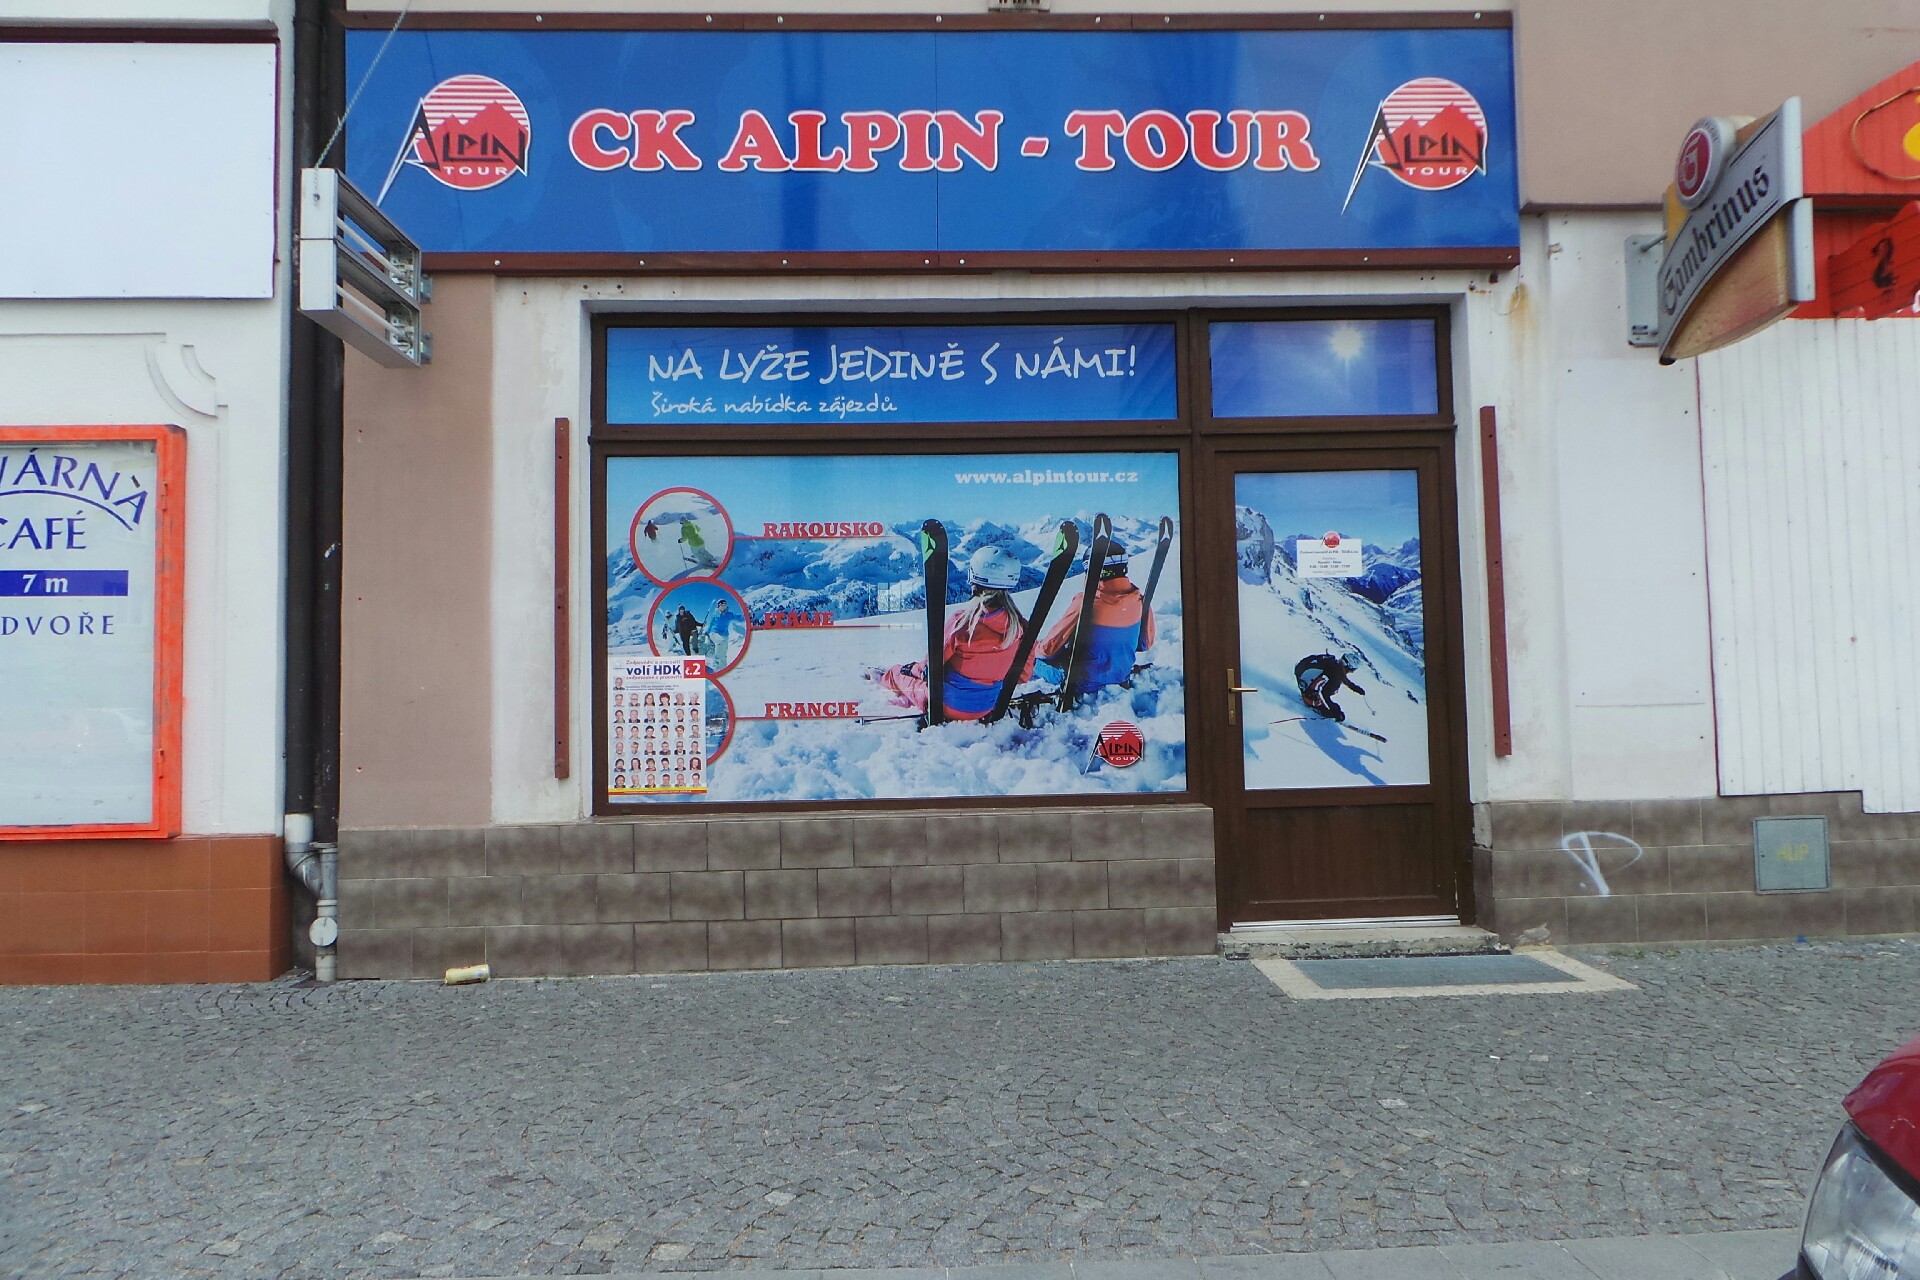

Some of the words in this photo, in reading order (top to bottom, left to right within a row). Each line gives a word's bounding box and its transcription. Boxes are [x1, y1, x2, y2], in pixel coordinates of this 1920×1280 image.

[568, 107, 703, 171] CK
[717, 109, 1004, 172] ALPIN
[1064, 109, 1321, 172] TOUR
[443, 165, 509, 176] TOUR
[1405, 166, 1469, 176] TOUR
[1663, 165, 1770, 316] Gambrinus
[648, 347, 704, 382] NA
[718, 344, 810, 383] LYŽE
[819, 341, 966, 385] JEDINĚ
[980, 342, 1001, 385] S
[1014, 336, 1137, 380] NÁMI!
[651, 391, 716, 417] Široká
[723, 393, 812, 414] nabídka
[819, 393, 898, 419] zájezdů
[954, 469, 1139, 487] www.alpintour.cz
[763, 522, 884, 538] RAKOUSKO
[21, 573, 37, 594] 7
[44, 576, 68, 594] m
[1, 611, 115, 636] DVOŘE
[626, 664, 650, 676] volí
[653, 664, 681, 676] HDK
[685, 663, 701, 676] č.2
[765, 702, 860, 717] FRANCIE
